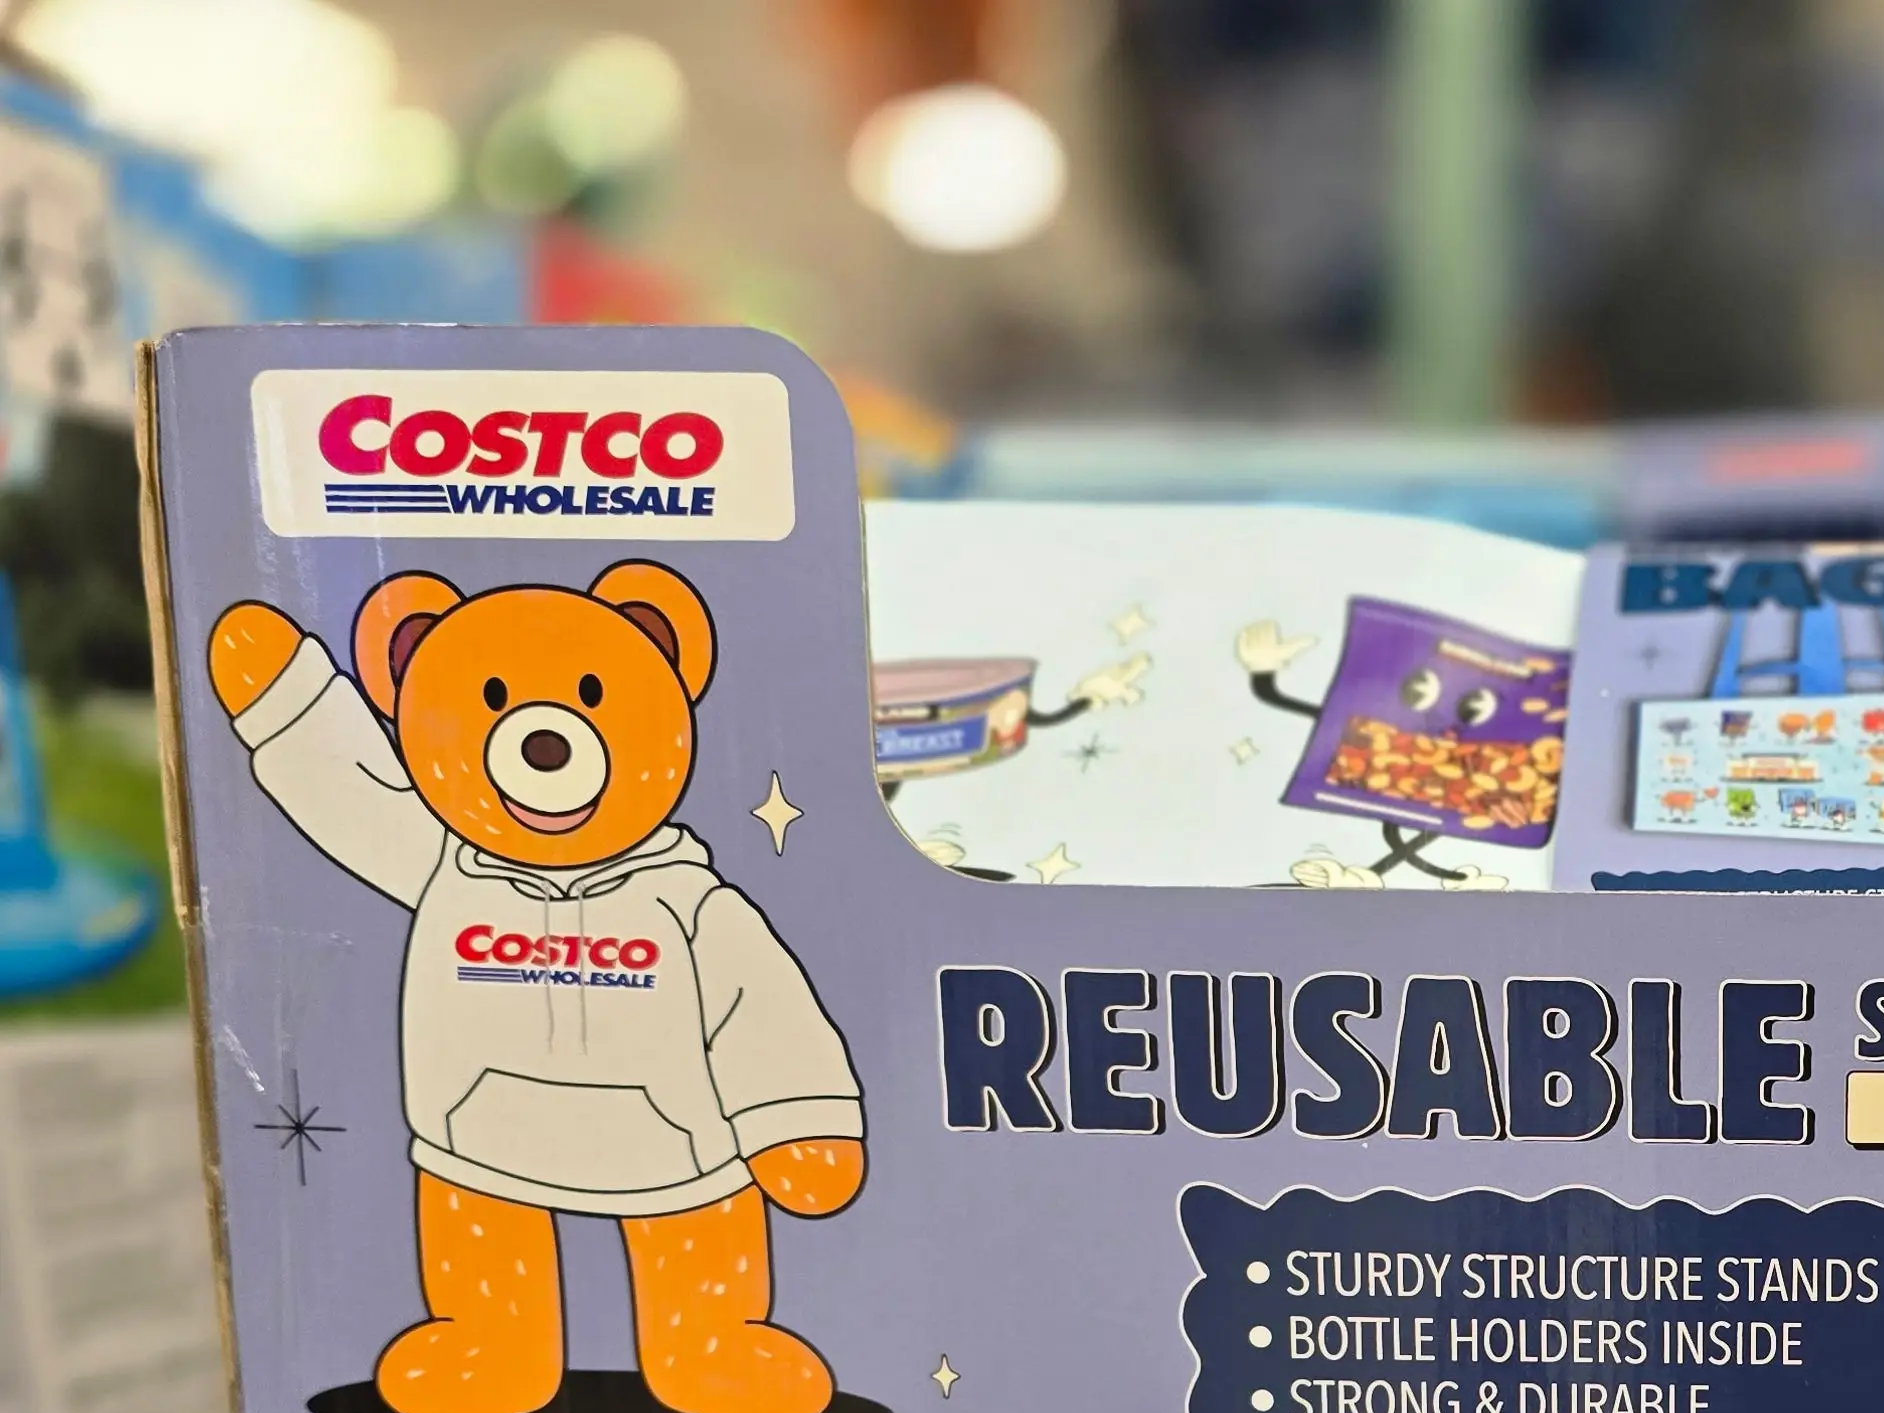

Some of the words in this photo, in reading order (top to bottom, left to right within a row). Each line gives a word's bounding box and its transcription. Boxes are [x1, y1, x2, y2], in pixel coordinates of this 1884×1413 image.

[318, 394, 724, 480] COSTCO
[449, 484, 716, 517] WHOLESALE
[454, 924, 661, 971] COSTCO
[934, 964, 1815, 1147] REUSABLE
[1286, 1250, 1456, 1300] STURDY
[1461, 1254, 1703, 1304] STRUCTURE
[1716, 1258, 1879, 1305] STANDS
[1288, 1316, 1436, 1363] BOTTLE
[1451, 1319, 1648, 1366] HOLDERS
[1662, 1321, 1803, 1367] INSIDE
